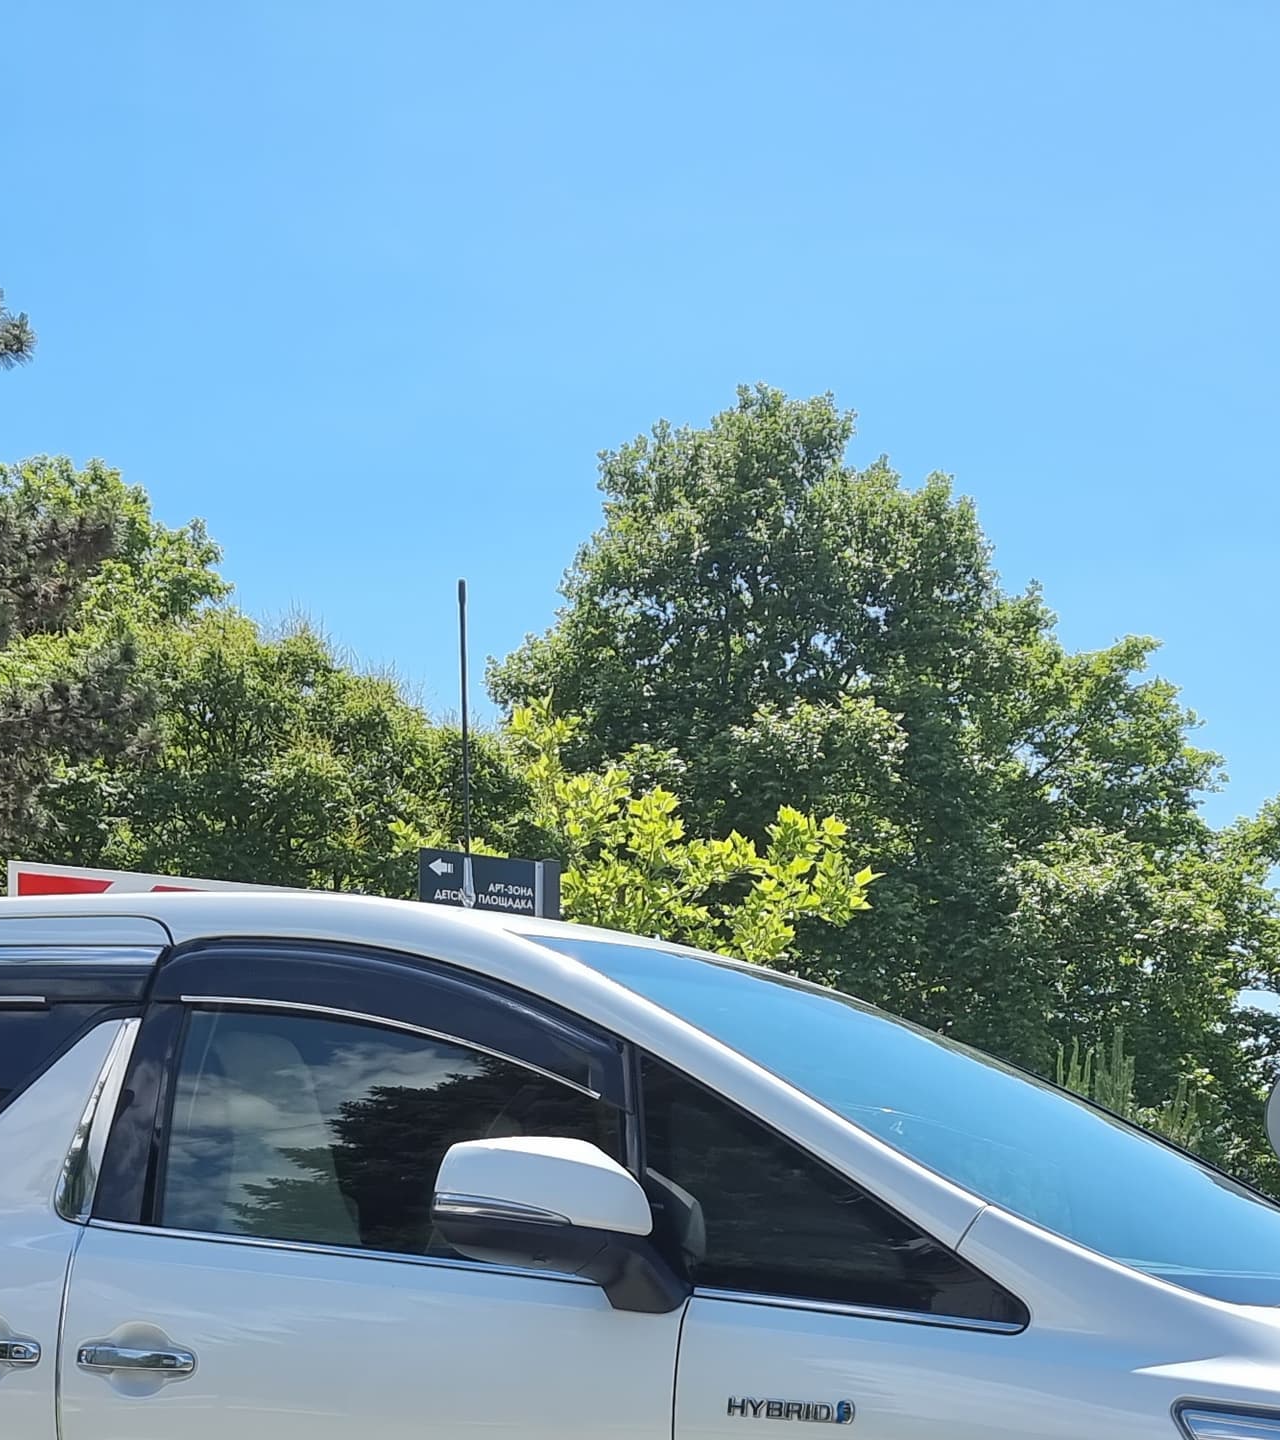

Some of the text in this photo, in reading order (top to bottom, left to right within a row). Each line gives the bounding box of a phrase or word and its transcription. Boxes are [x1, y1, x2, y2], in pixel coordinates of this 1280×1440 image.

[488, 883, 533, 897] АРТ-ЗОНА
[478, 894, 533, 909] ПЛОЩАДКА
[727, 1396, 834, 1422] HYBRID
